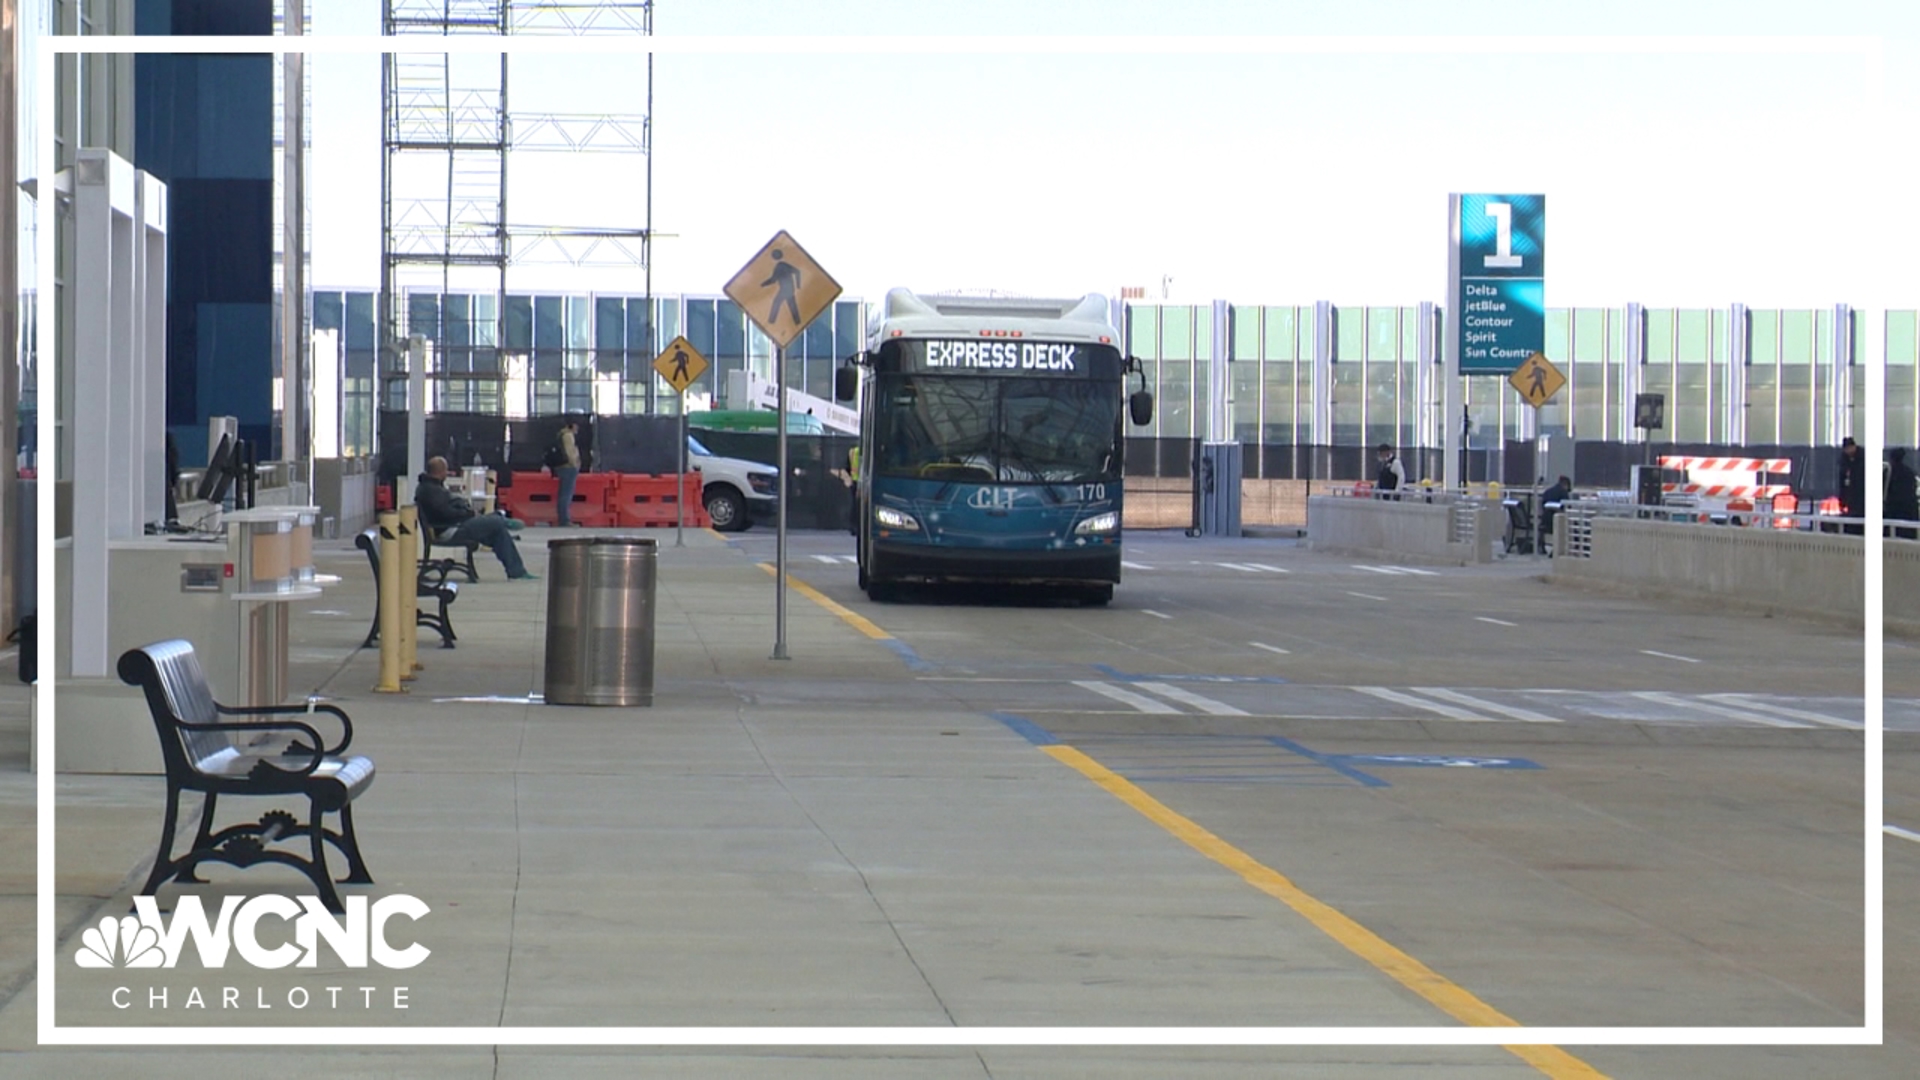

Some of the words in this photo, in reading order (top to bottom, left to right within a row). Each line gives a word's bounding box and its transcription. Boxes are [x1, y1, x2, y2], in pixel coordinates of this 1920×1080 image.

[1484, 203, 1523, 268] 1
[1466, 285, 1498, 296] Delta
[1465, 300, 1507, 313] jetBlue
[1465, 316, 1514, 327] Contour
[1465, 331, 1497, 344] Spirit
[926, 341, 1017, 368] EXPRESS
[1022, 344, 1075, 370] DECK
[1465, 347, 1486, 358] Sun
[977, 487, 1018, 509] CLT
[1077, 483, 1105, 500] 170
